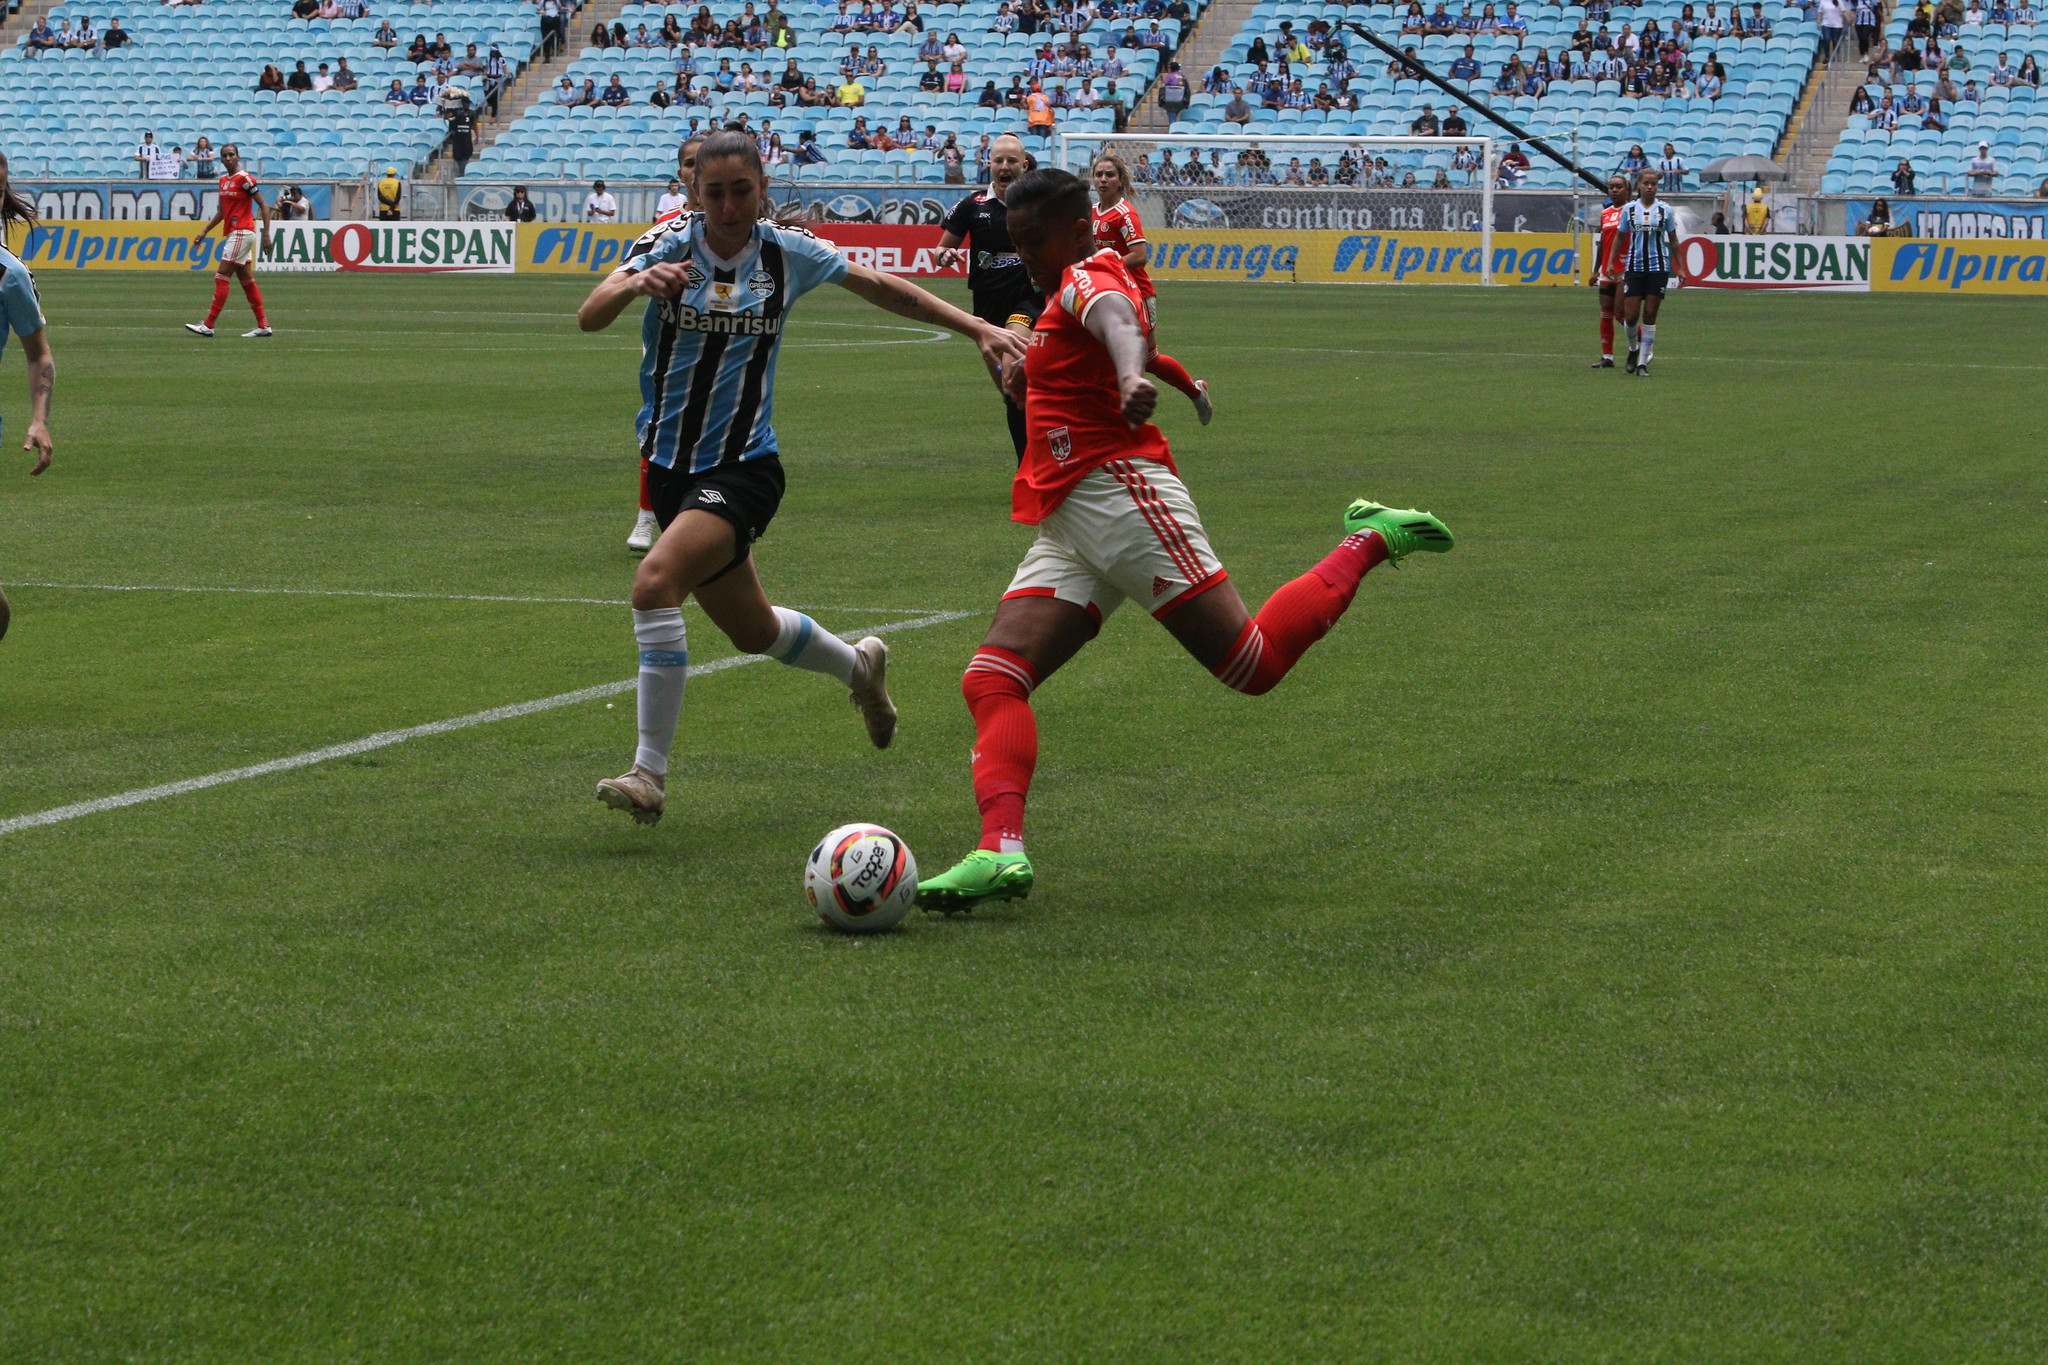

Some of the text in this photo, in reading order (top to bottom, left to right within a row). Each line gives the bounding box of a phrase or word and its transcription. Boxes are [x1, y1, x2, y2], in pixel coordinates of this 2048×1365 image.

[1263, 203, 1372, 230] contigo
[1390, 206, 1426, 230] na
[257, 223, 513, 272] MARQUESPAN
[1146, 243, 1299, 279] iranga
[1380, 238, 1575, 283] Ipiranga
[1664, 236, 1871, 288] QUESPAN
[1937, 246, 2048, 289] Ipira
[680, 305, 783, 335] Banrisul
